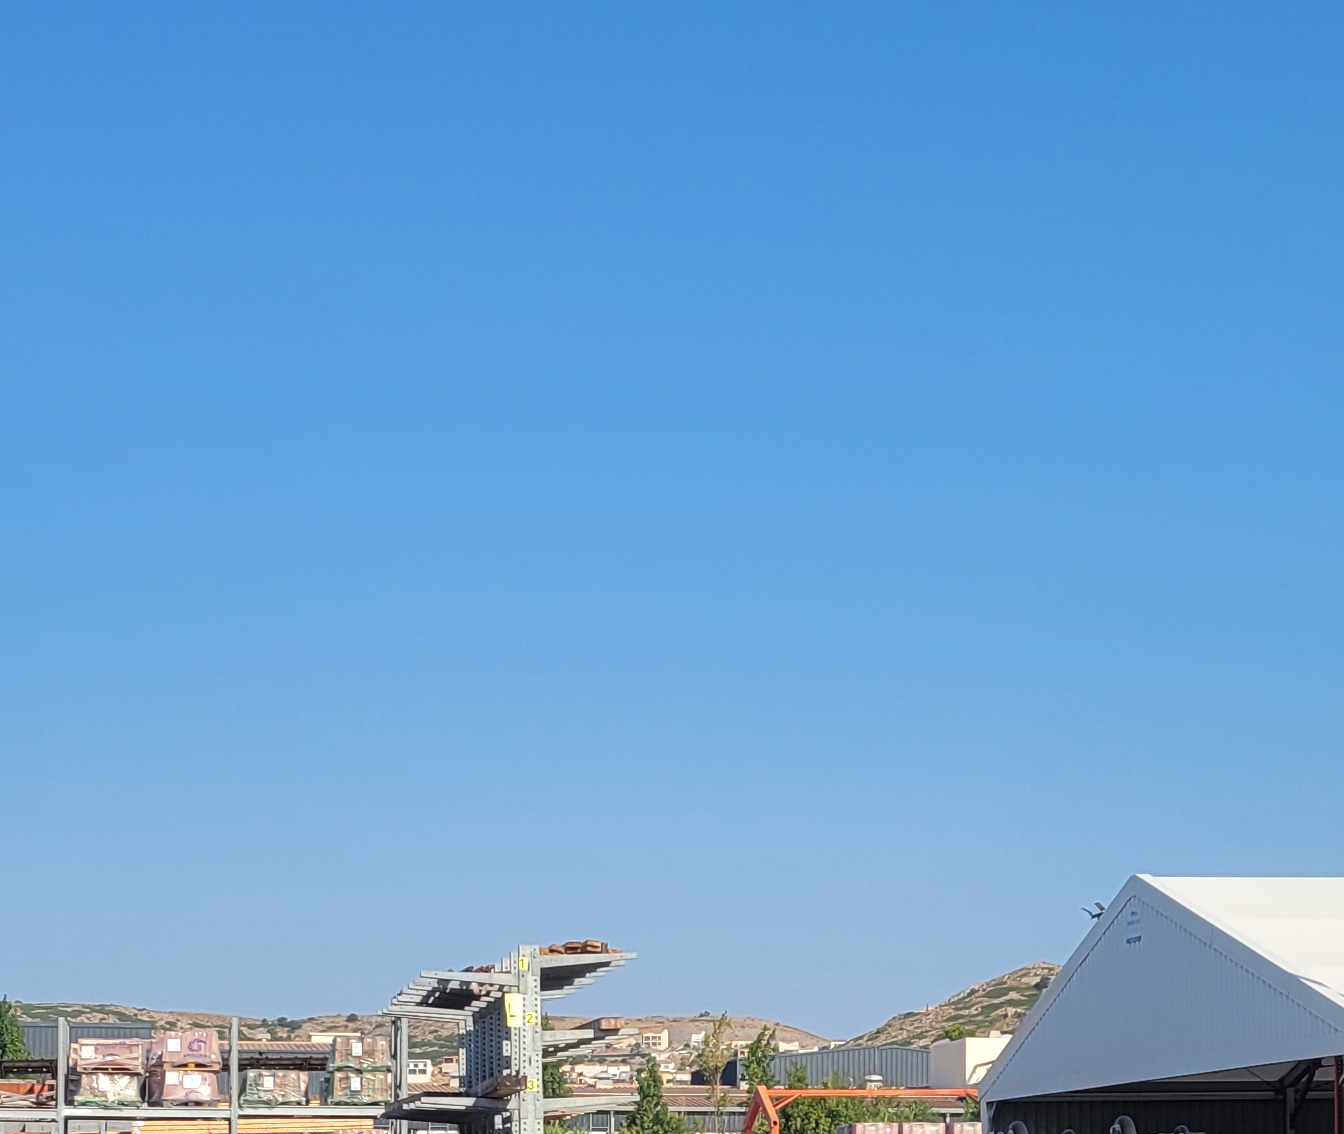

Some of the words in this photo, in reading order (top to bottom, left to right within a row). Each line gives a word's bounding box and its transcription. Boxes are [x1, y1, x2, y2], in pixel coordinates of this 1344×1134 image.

[508, 1002, 516, 1018] L
[526, 1013, 534, 1024] 2
[527, 1080, 534, 1090] 3
